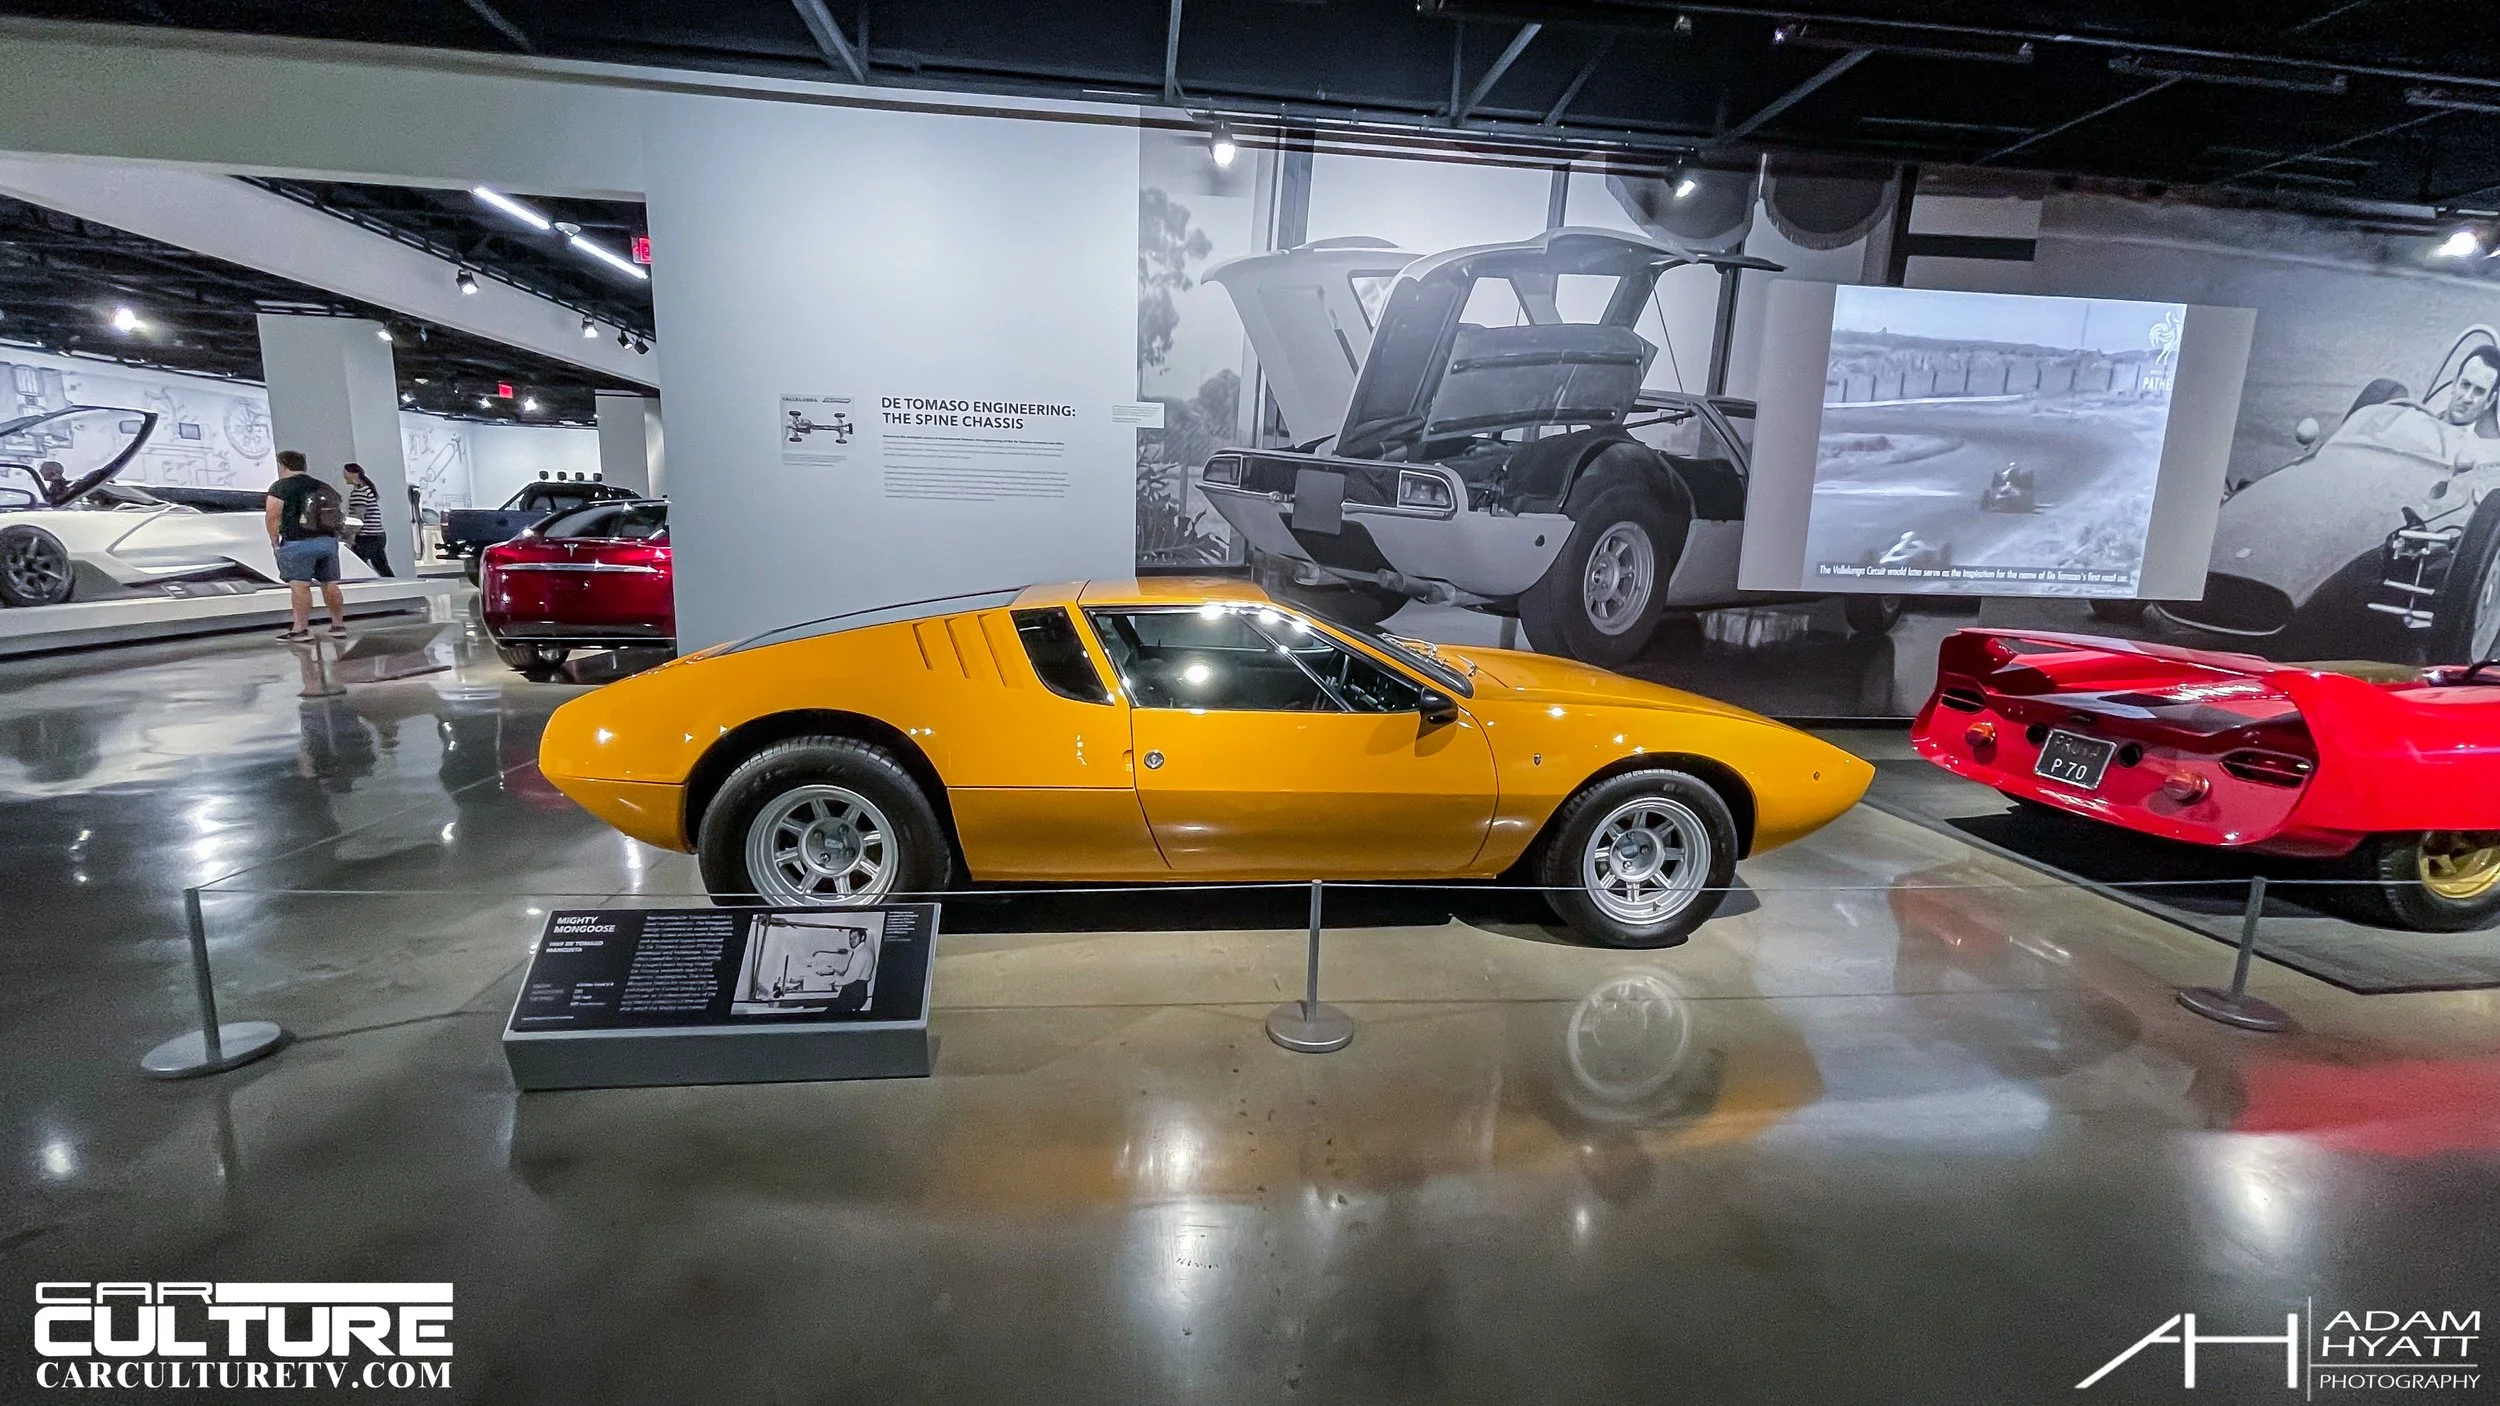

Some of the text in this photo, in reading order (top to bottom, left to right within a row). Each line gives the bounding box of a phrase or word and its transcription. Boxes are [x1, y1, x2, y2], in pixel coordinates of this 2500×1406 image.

[881, 397, 1076, 417] DE TOMASO ENGINEERING:
[882, 412, 1024, 429] THE SPINE CHASSIS
[1820, 565, 1831, 574] The
[1888, 566, 1907, 576] would
[1924, 568, 1940, 577] serve
[1951, 568, 1962, 577] the
[1996, 568, 2006, 579] for
[2007, 569, 2017, 579] the
[2050, 757, 2088, 780] P 70
[556, 916, 599, 925] MIGHTY
[553, 925, 616, 933] MONGOOSE
